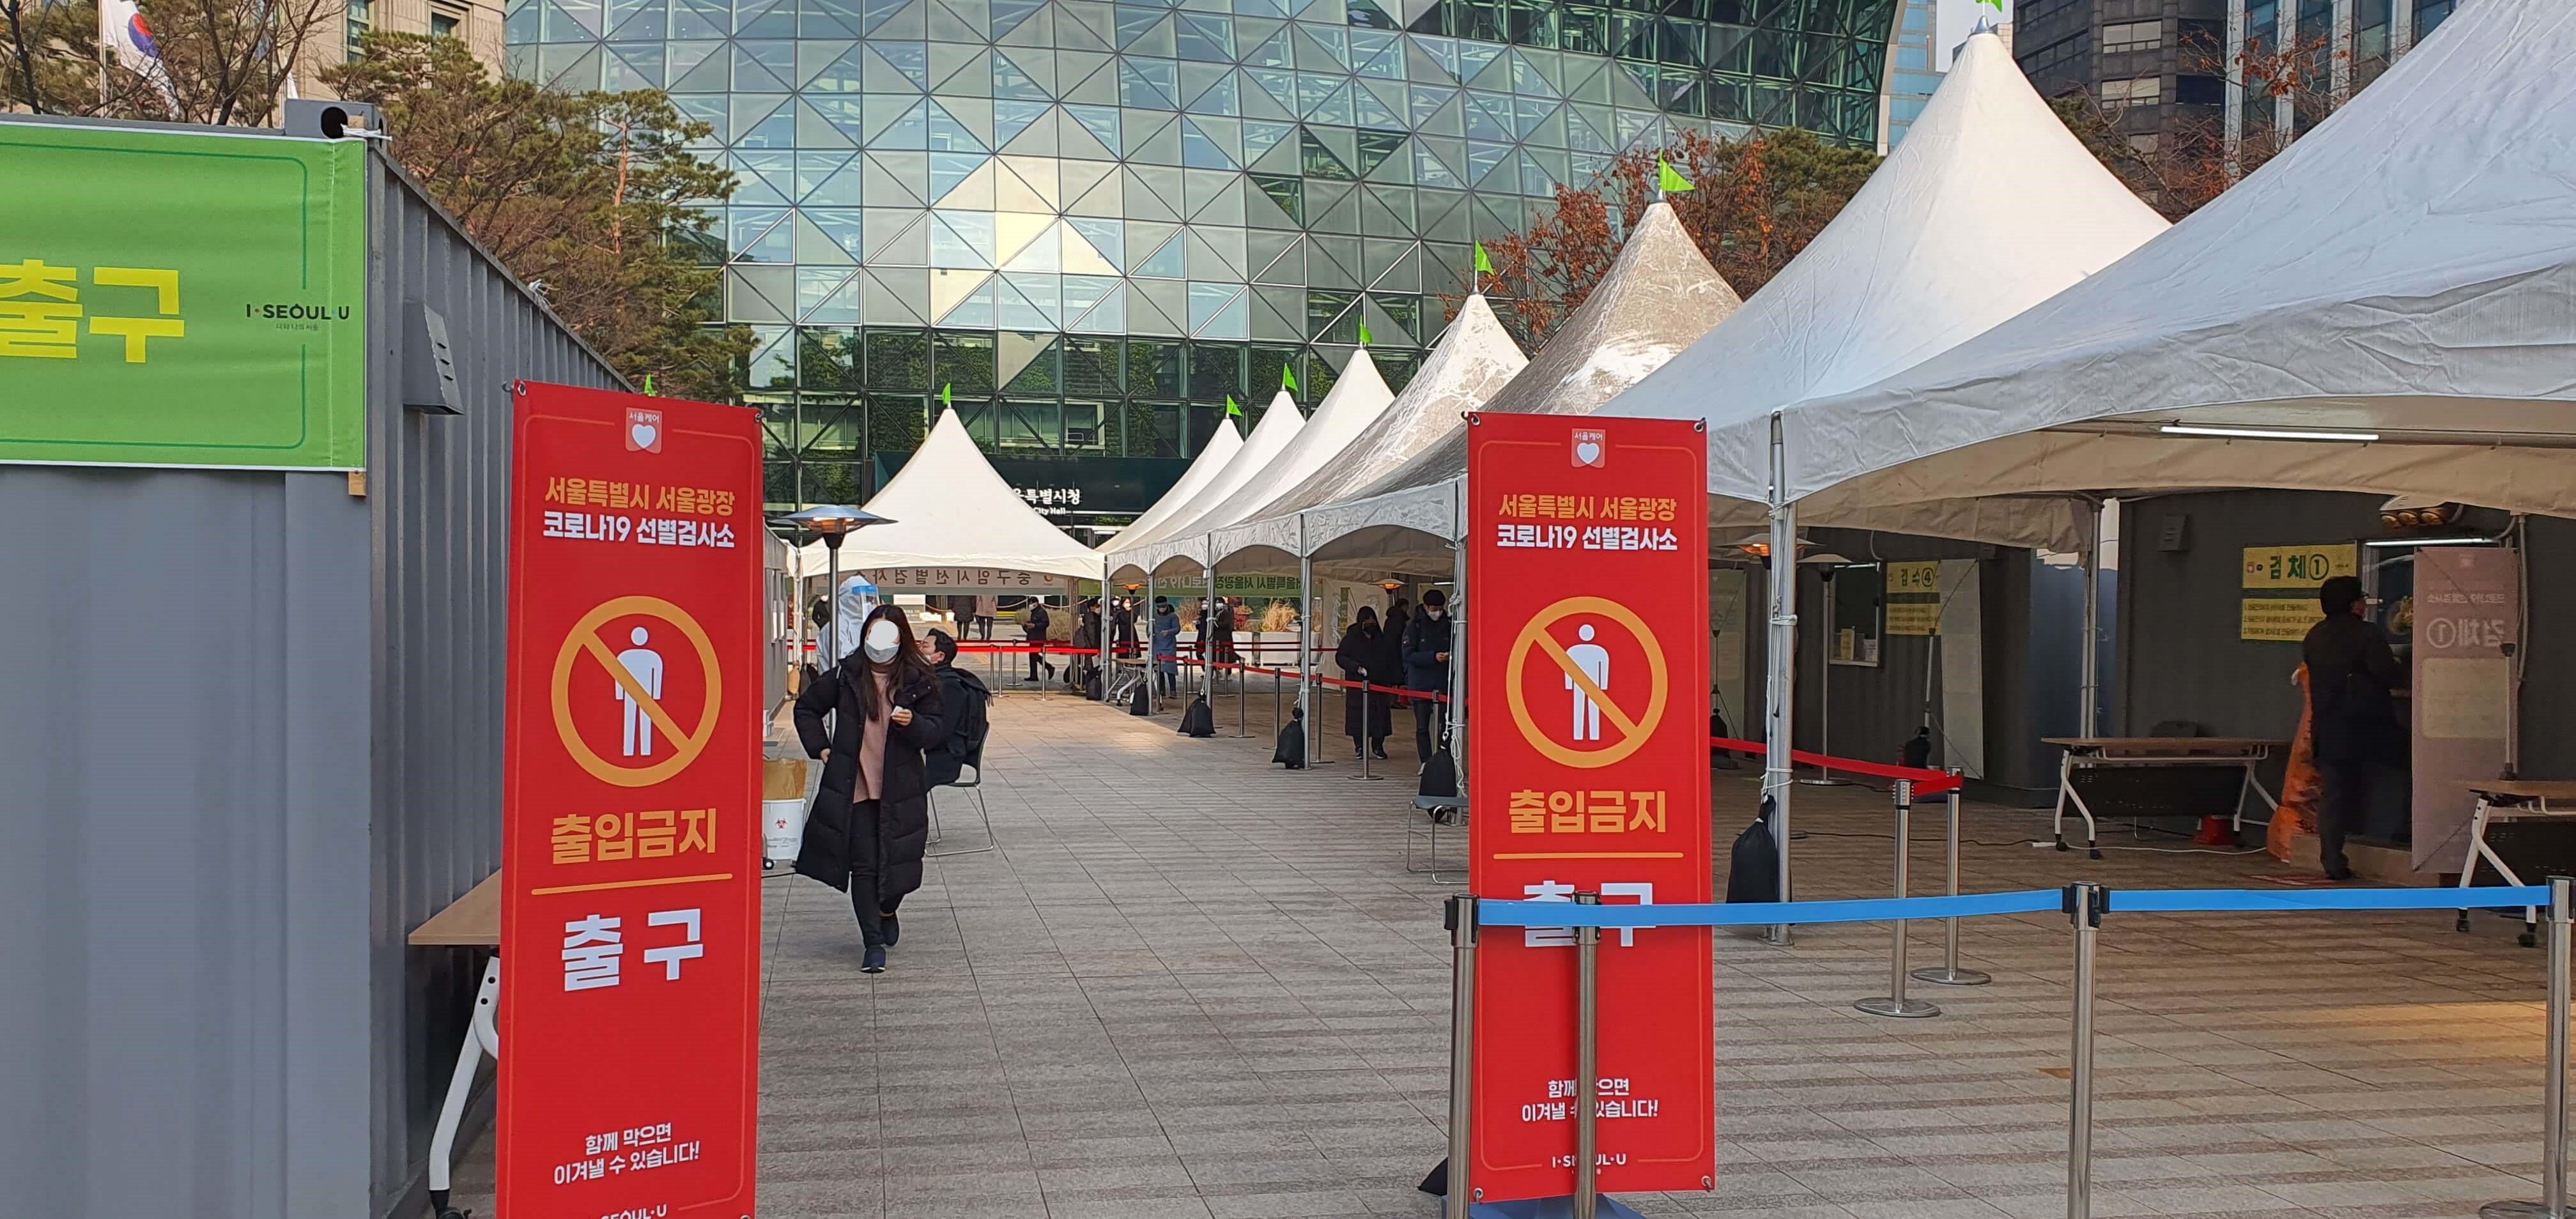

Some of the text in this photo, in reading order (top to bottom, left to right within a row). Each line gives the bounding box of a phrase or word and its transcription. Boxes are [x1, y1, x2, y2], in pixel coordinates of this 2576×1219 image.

[0, 259, 185, 364] 출구
[628, 412, 660, 424] 서울케어
[1574, 432, 1603, 441] 서울케어
[544, 477, 735, 516] 서울특별시 서울광장
[1050, 507, 1066, 515] Hall
[1498, 494, 1677, 521] 서울특별시 서울광장
[543, 510, 736, 548] 코로나19 선별검사소
[1497, 524, 1678, 551] 코로나19 선별검사소
[1509, 789, 1666, 833] 출입금지
[551, 808, 716, 865] 출입금지
[1596, 1078, 1630, 1097] 으면
[1521, 1102, 1566, 1122] 이겨낼
[585, 1121, 672, 1156] 함께 막으면
[554, 1140, 700, 1185] 이겨낼 수 있습니다!
